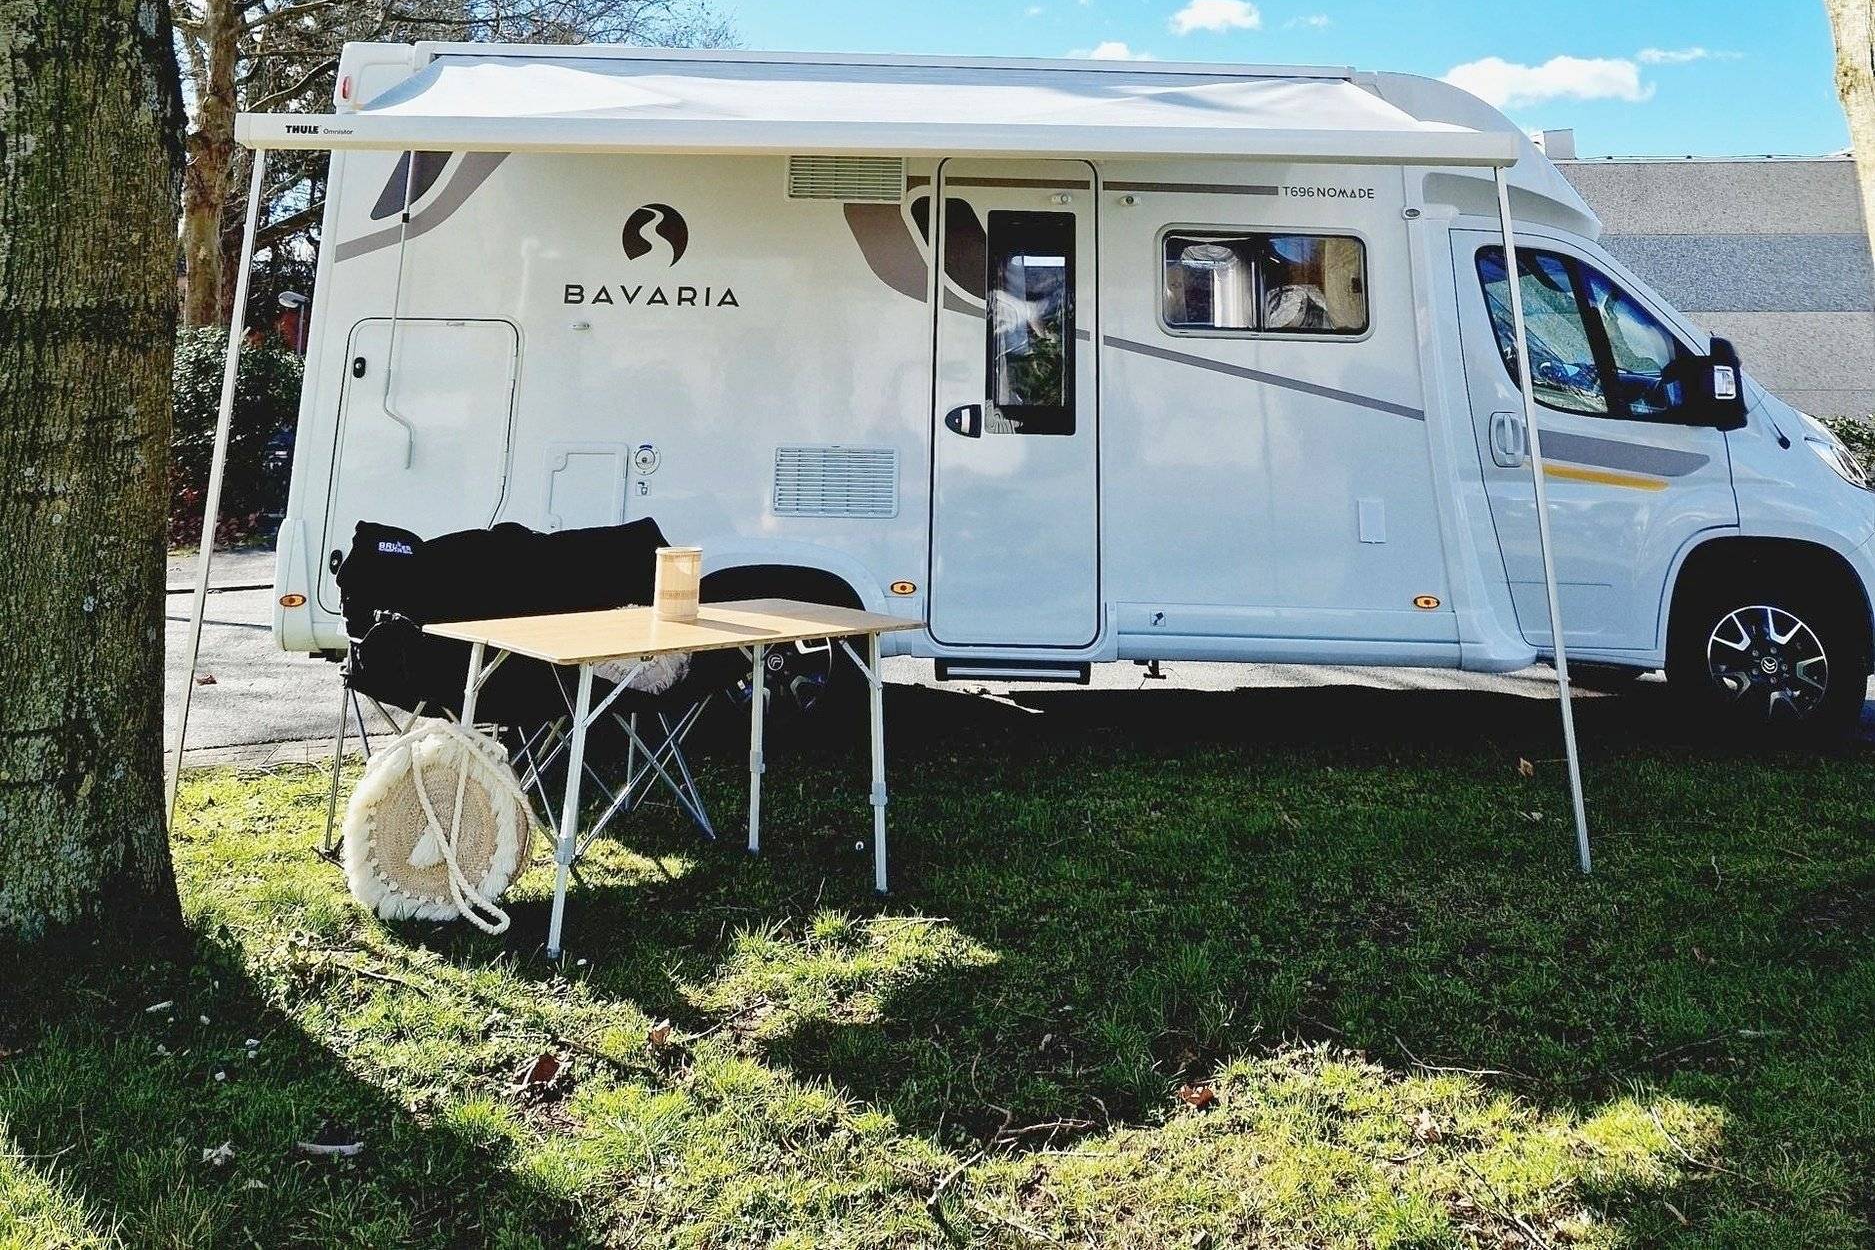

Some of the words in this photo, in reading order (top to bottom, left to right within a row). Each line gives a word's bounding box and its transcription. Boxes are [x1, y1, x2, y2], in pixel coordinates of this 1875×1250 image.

[285, 124, 320, 135] THULE
[1282, 186, 1315, 198] T696
[1316, 187, 1375, 199] NOMADE
[563, 283, 740, 308] BAVARIA
